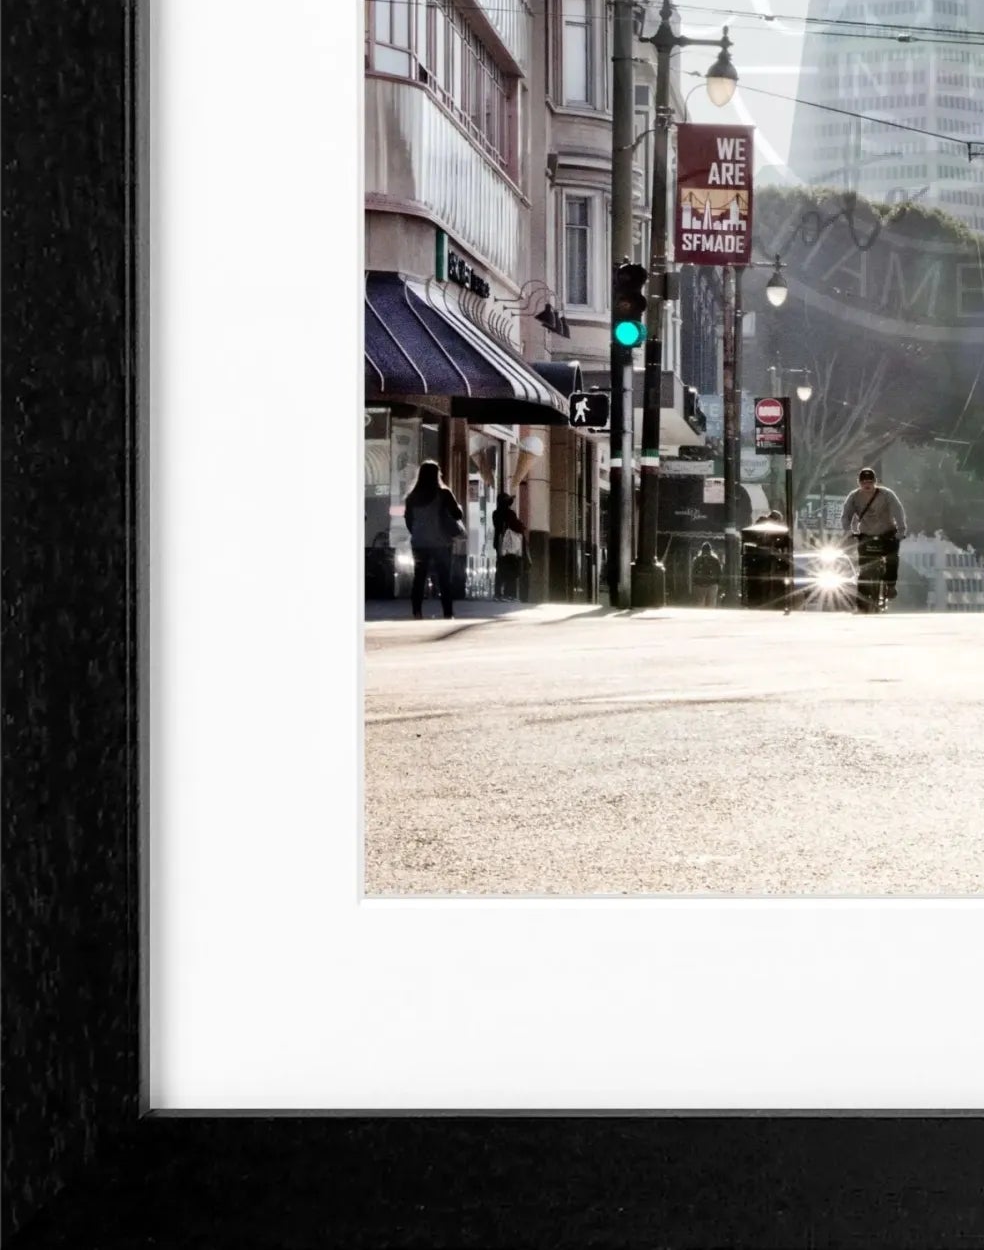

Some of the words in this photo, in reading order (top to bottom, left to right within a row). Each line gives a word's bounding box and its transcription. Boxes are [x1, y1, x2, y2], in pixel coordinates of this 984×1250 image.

[716, 137, 746, 161] WE
[708, 161, 745, 186] ARE
[682, 233, 745, 254] SFMADE
